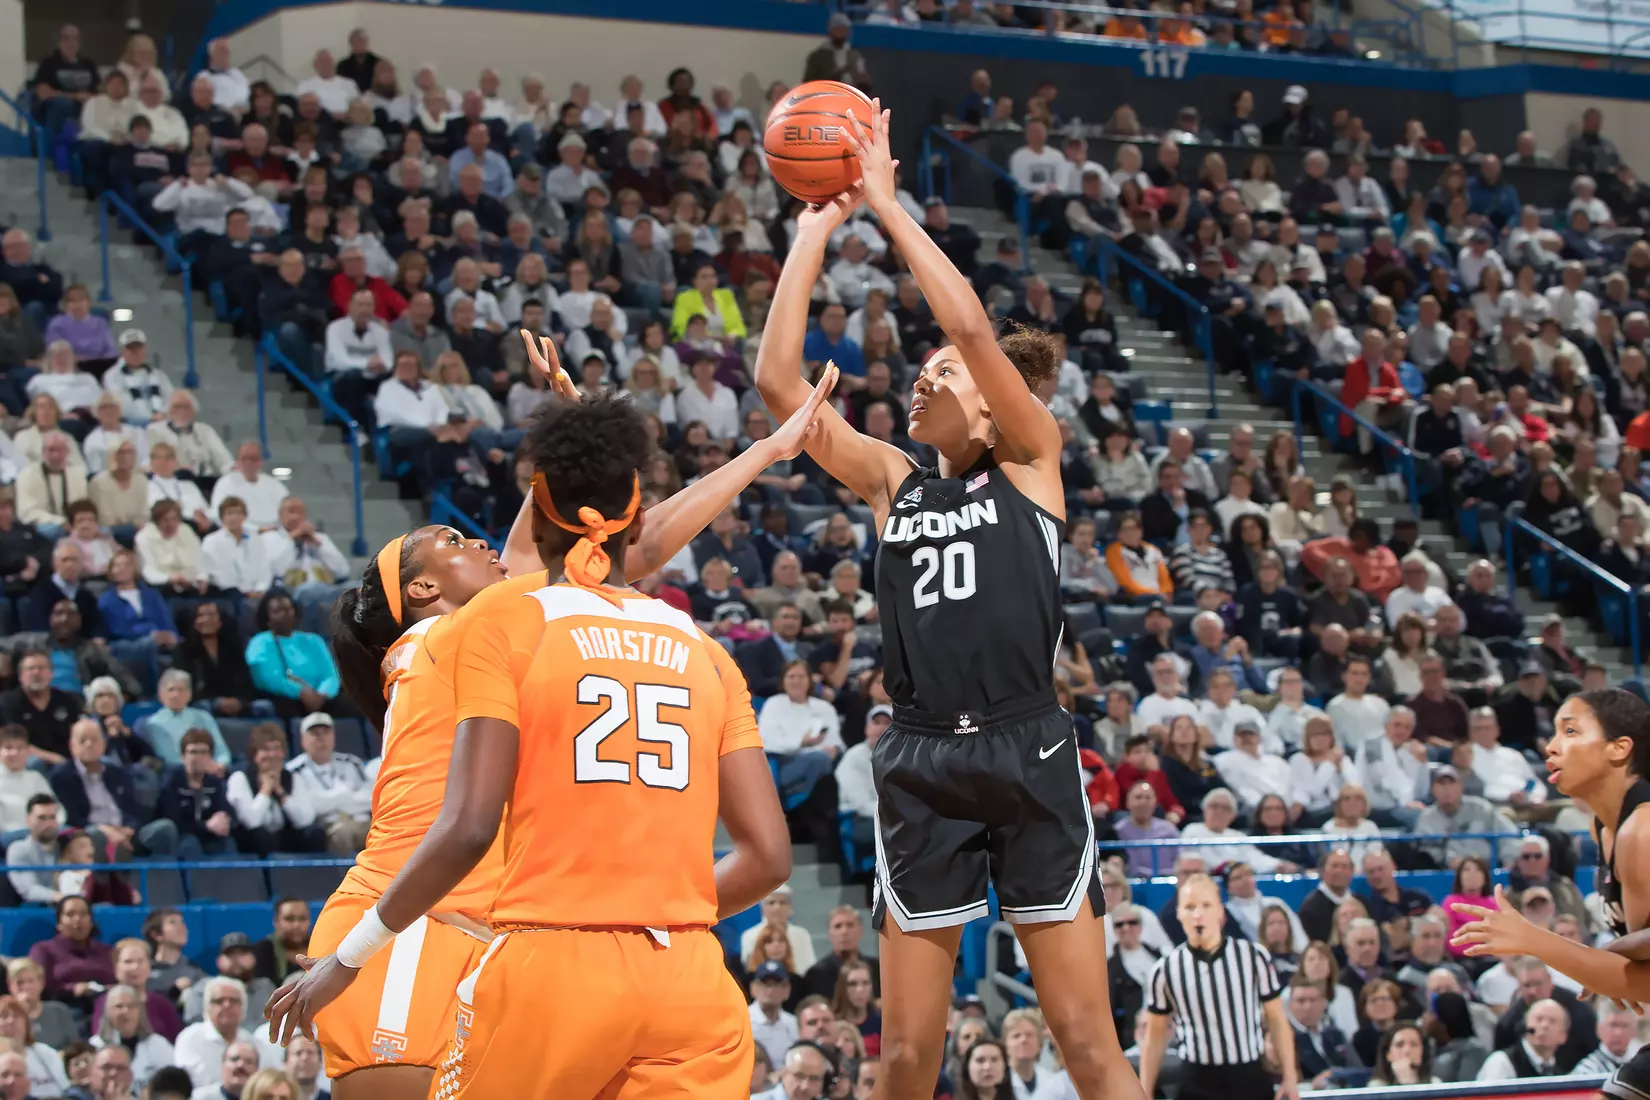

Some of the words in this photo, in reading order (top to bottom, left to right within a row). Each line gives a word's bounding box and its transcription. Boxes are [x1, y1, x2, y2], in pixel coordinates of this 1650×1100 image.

[1140, 50, 1188, 78] 117
[784, 126, 840, 141] ELITE
[883, 499, 998, 542] UCONN
[911, 541, 977, 609] 20
[570, 627, 690, 675] HORSTON
[574, 673, 691, 792] 25
[954, 726, 979, 735] UCONN
